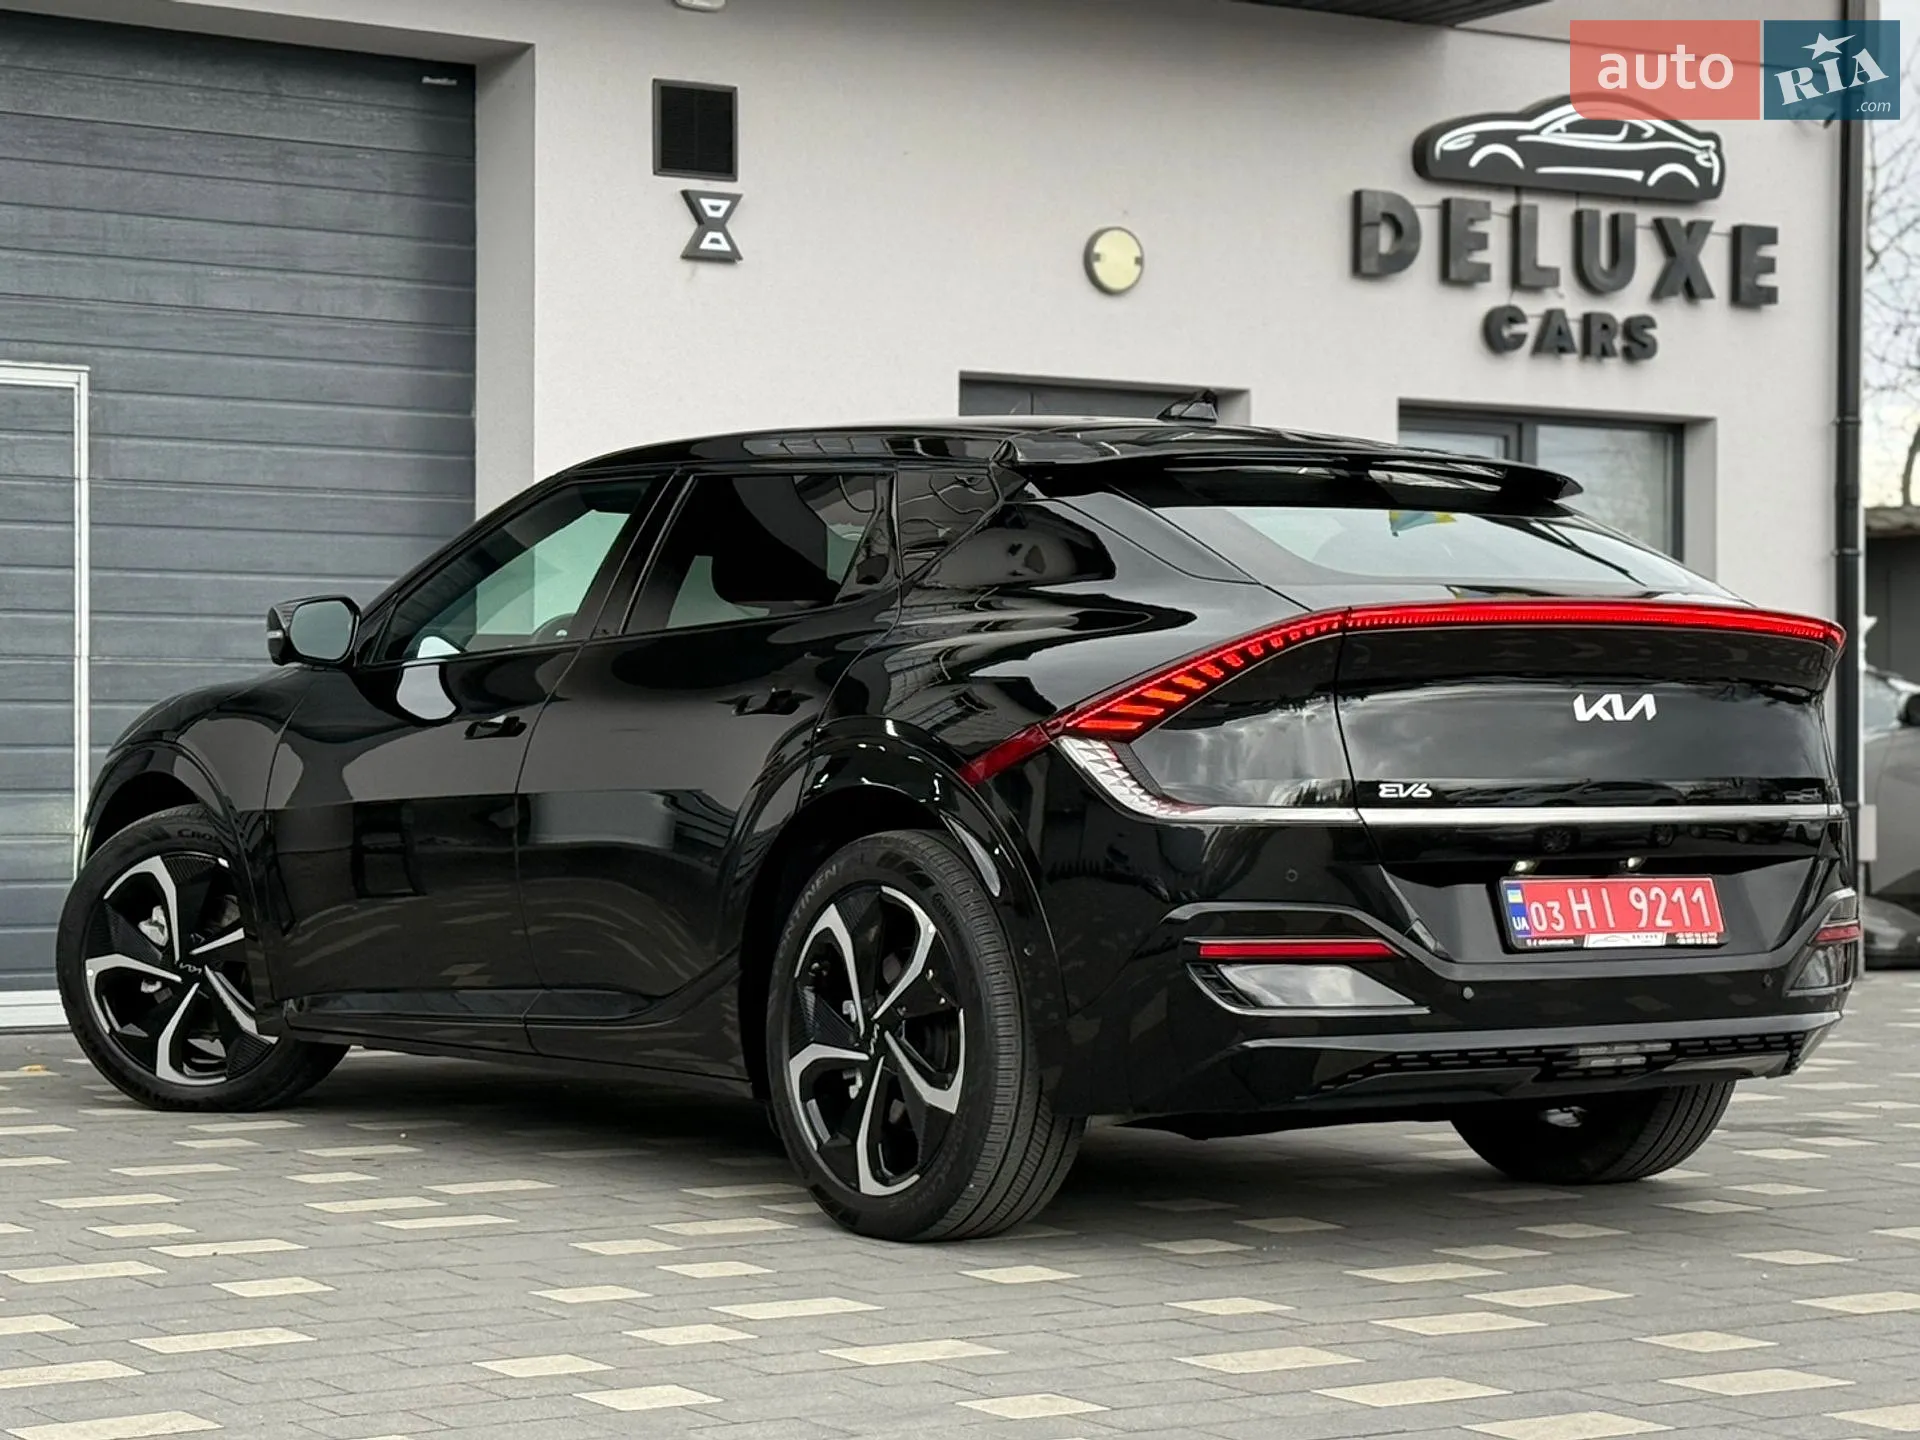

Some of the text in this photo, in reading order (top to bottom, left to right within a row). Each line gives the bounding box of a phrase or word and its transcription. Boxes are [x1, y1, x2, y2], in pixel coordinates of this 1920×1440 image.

[1351, 188, 1779, 308] DELUXE
[1483, 304, 1658, 361] CARS
[1573, 693, 1657, 722] KIA
[1378, 783, 1433, 799] EV6
[1512, 916, 1530, 931] UA
[1530, 886, 1712, 932] 03 HI 9211
